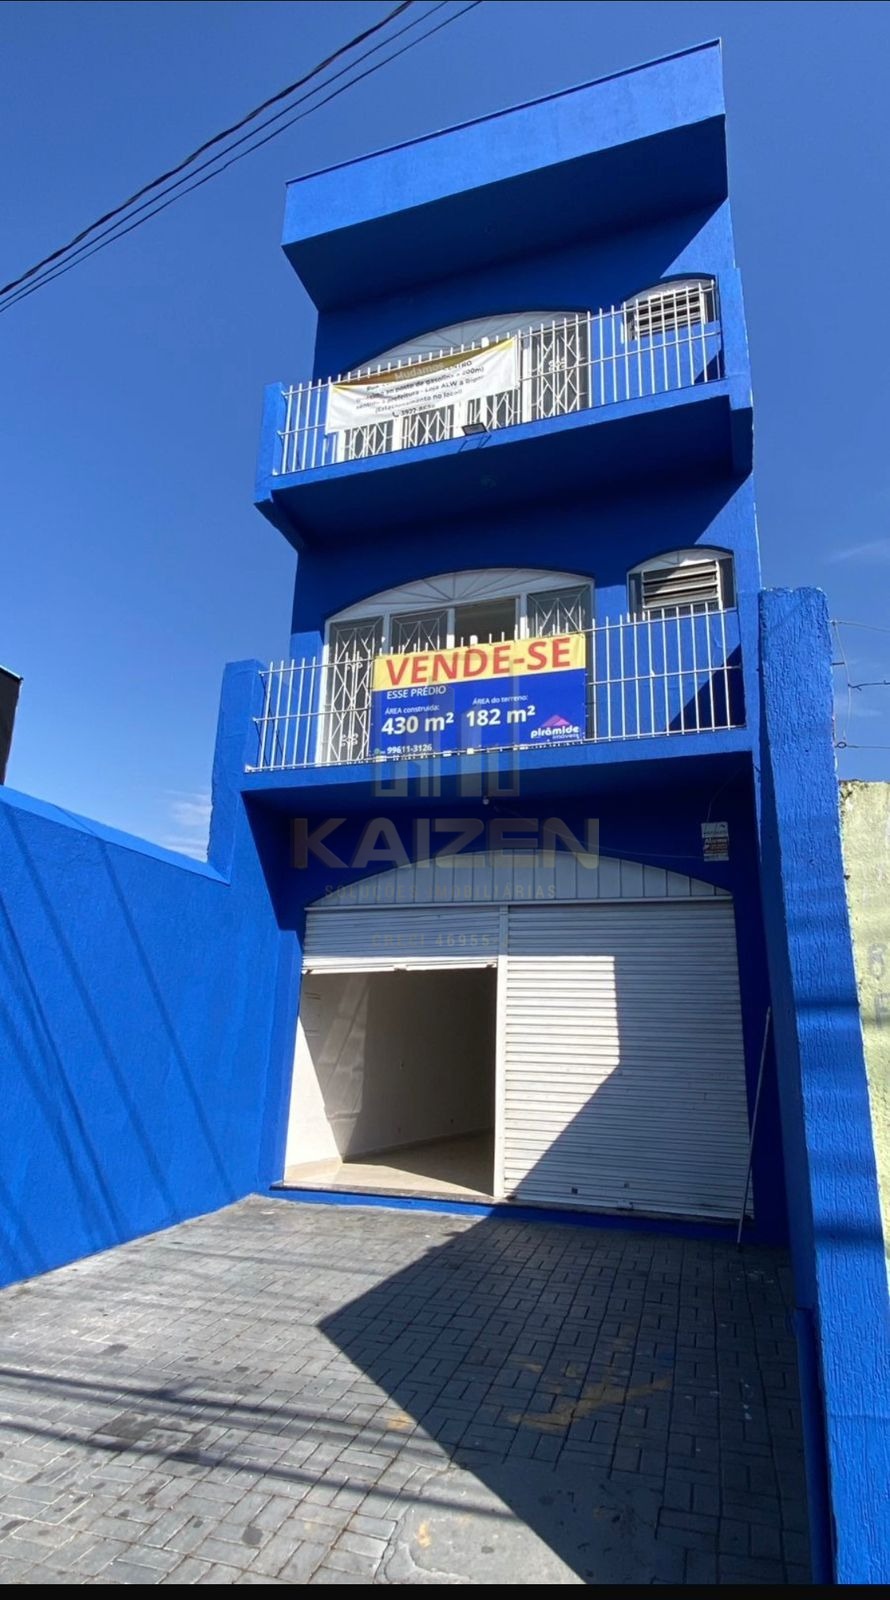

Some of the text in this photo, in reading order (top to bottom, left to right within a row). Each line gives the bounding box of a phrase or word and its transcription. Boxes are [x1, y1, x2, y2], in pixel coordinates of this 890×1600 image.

[386, 637, 571, 686] VENDE-SE
[387, 685, 447, 700] ESSE PRÉDIO
[472, 697, 490, 705] ÁREA
[385, 706, 402, 715] ÁREA
[466, 708, 501, 727] 182
[381, 716, 419, 735] 430
[387, 744, 432, 755] 99611-3126
